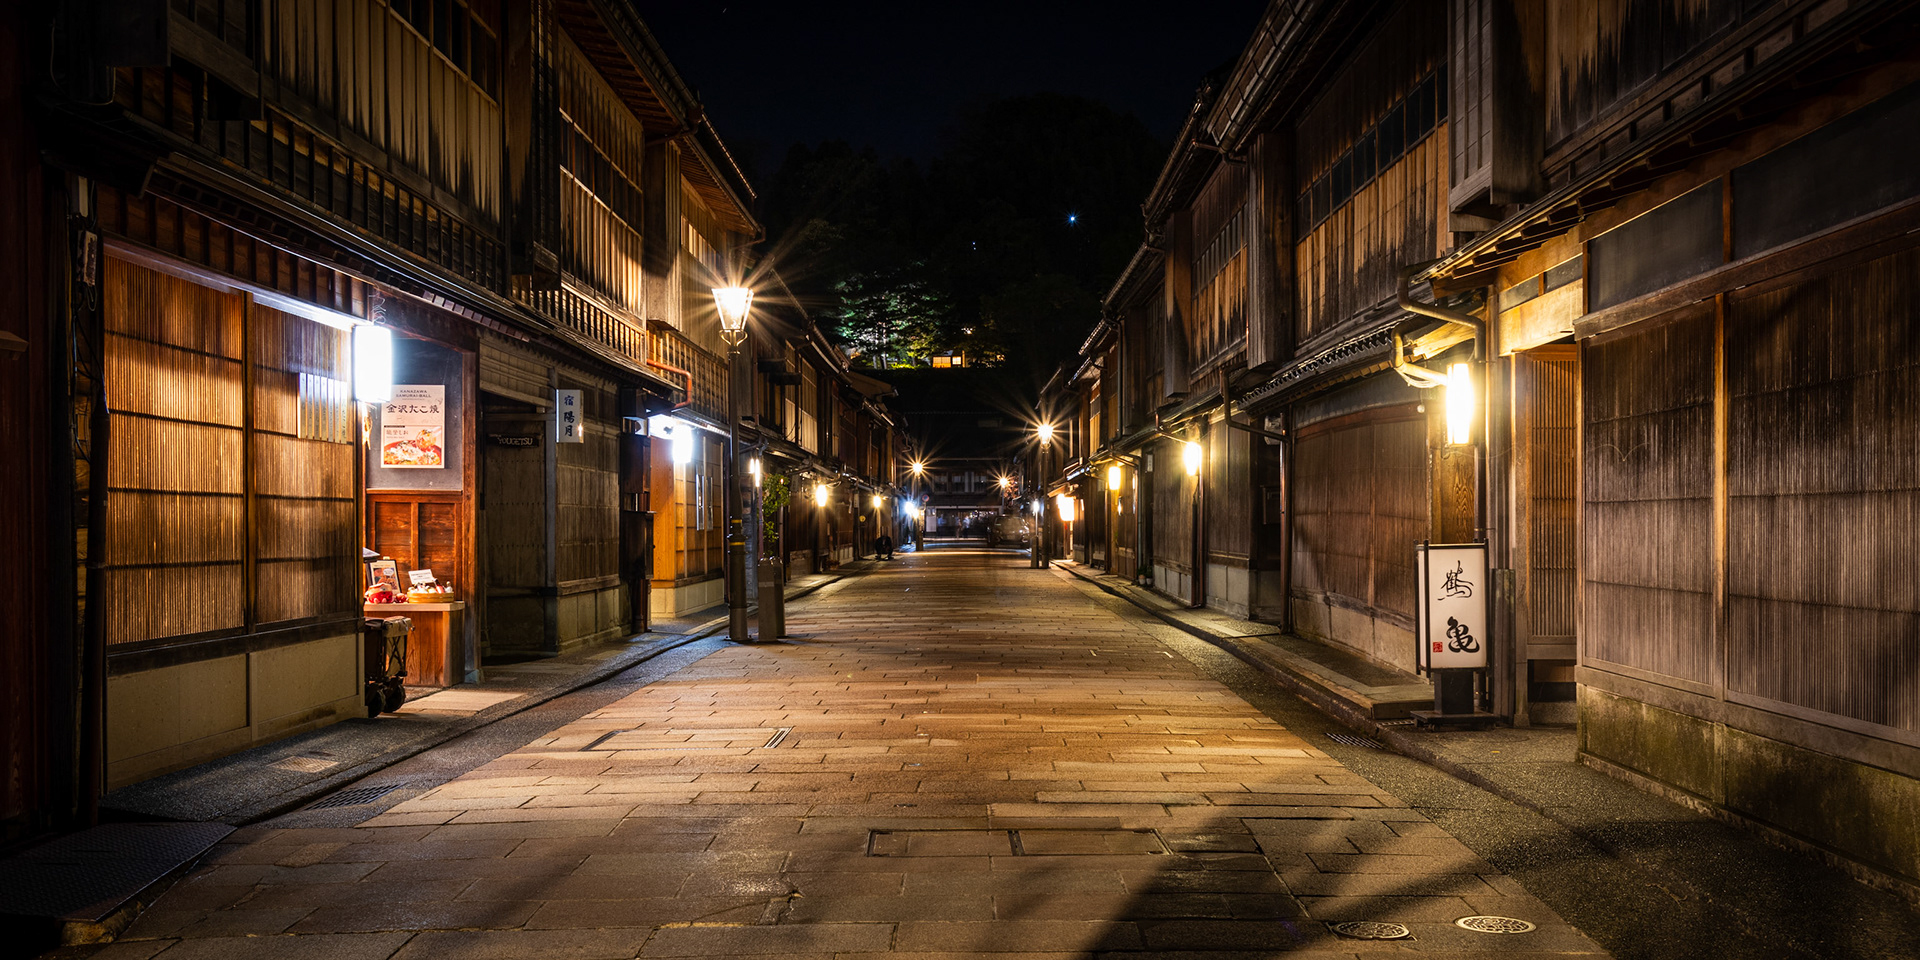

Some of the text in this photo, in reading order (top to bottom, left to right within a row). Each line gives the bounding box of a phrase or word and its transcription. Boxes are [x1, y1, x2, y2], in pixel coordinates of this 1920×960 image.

[386, 403, 440, 414] 金沢たこ焼
[497, 437, 533, 446] YOUGETSU
